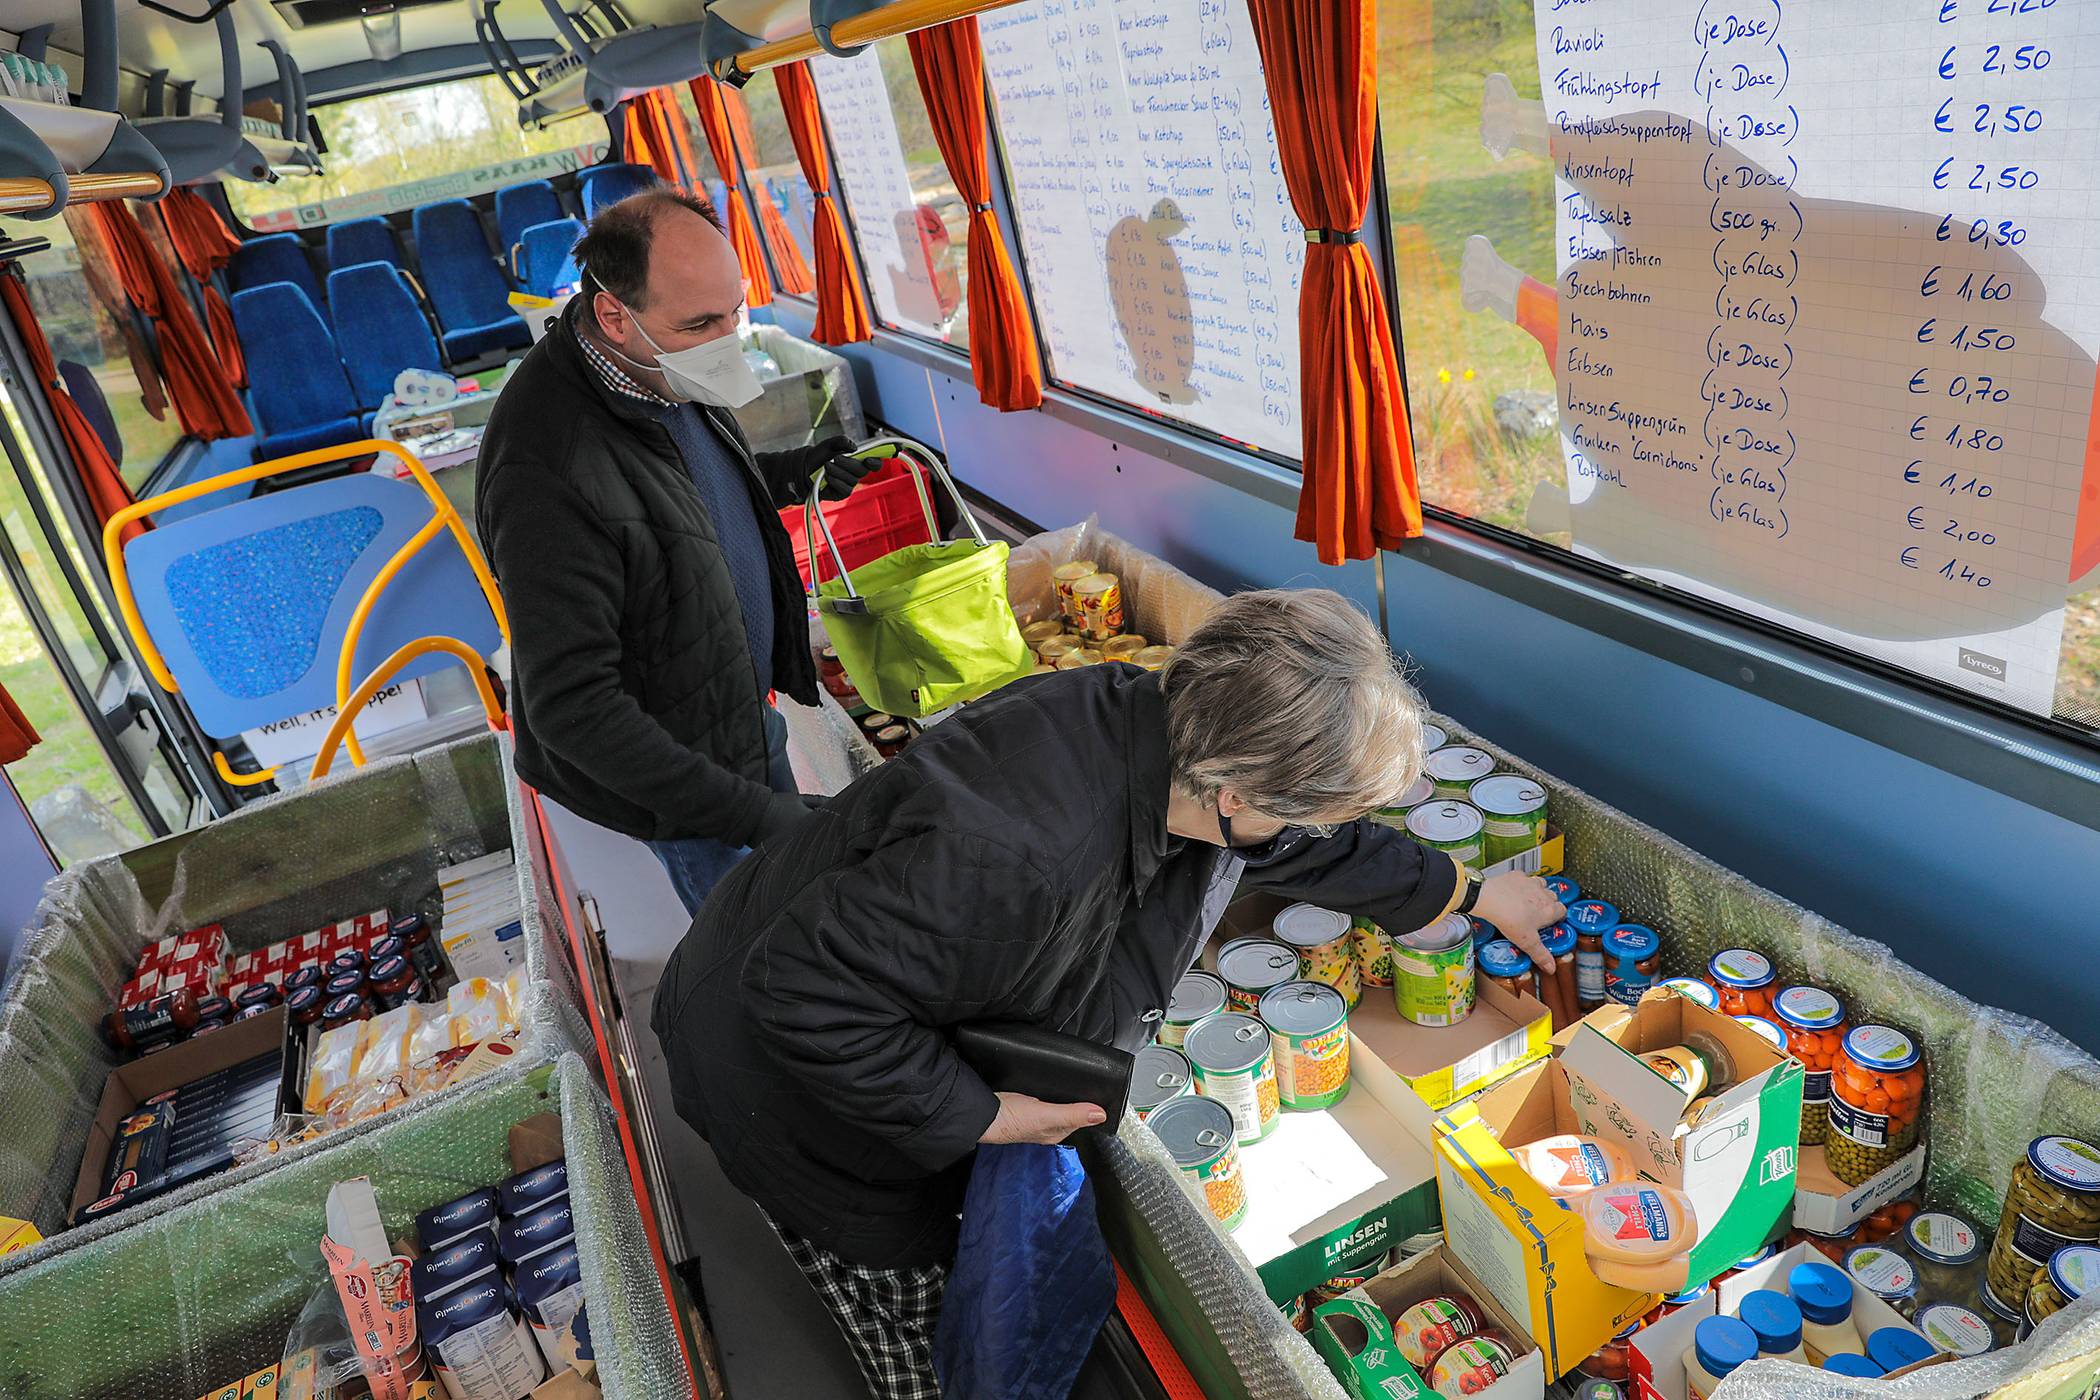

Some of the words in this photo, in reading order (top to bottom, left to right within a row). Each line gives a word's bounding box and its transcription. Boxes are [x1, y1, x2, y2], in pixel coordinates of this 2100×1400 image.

[1551, 26, 1604, 54] Ravioli
[1938, 46, 1957, 80] €
[1982, 45, 2051, 76] 2,50
[1554, 68, 1661, 104] Frühlingstopf
[1934, 97, 1954, 133] €
[1974, 104, 2043, 138] 2,50
[1564, 152, 1634, 187] Linsentopf
[1933, 156, 1954, 190] €
[1968, 164, 2038, 194] 2,50
[1563, 192, 1632, 236] Tafelsalz
[1936, 213, 1953, 242] €
[1968, 218, 2027, 250] 0,30
[1921, 265, 1942, 297] €
[1956, 272, 2012, 302] 1,60
[1570, 312, 1609, 339] Mais
[1917, 318, 1937, 343] €
[1949, 324, 2015, 352] 1,50
[1567, 347, 1613, 377] Erbsen
[1908, 367, 1931, 394] €
[1949, 376, 2010, 404] 0,70
[1572, 423, 1621, 454] Gurken
[1910, 416, 1929, 441] €
[1945, 424, 2004, 452] 1,80
[1571, 453, 1627, 488] Rotkohl
[1904, 460, 1923, 484] €
[1939, 472, 1992, 498] 1,10
[1907, 506, 1924, 530] €
[1943, 519, 1996, 546] 2,00
[1900, 546, 1920, 570] €
[1939, 558, 1991, 588] 1,40
[1967, 656, 1999, 673] Lyreco
[1609, 987, 1641, 1002] Würstch
[1772, 1152, 1787, 1180] Knorr
[1631, 1204, 1643, 1229] CHILI
[1644, 1192, 1667, 1238] HELLMANN'S
[1324, 1216, 1388, 1259] LINSEN
[1327, 1256, 1341, 1267] mit
[1342, 1232, 1387, 1259] Suppengrün
